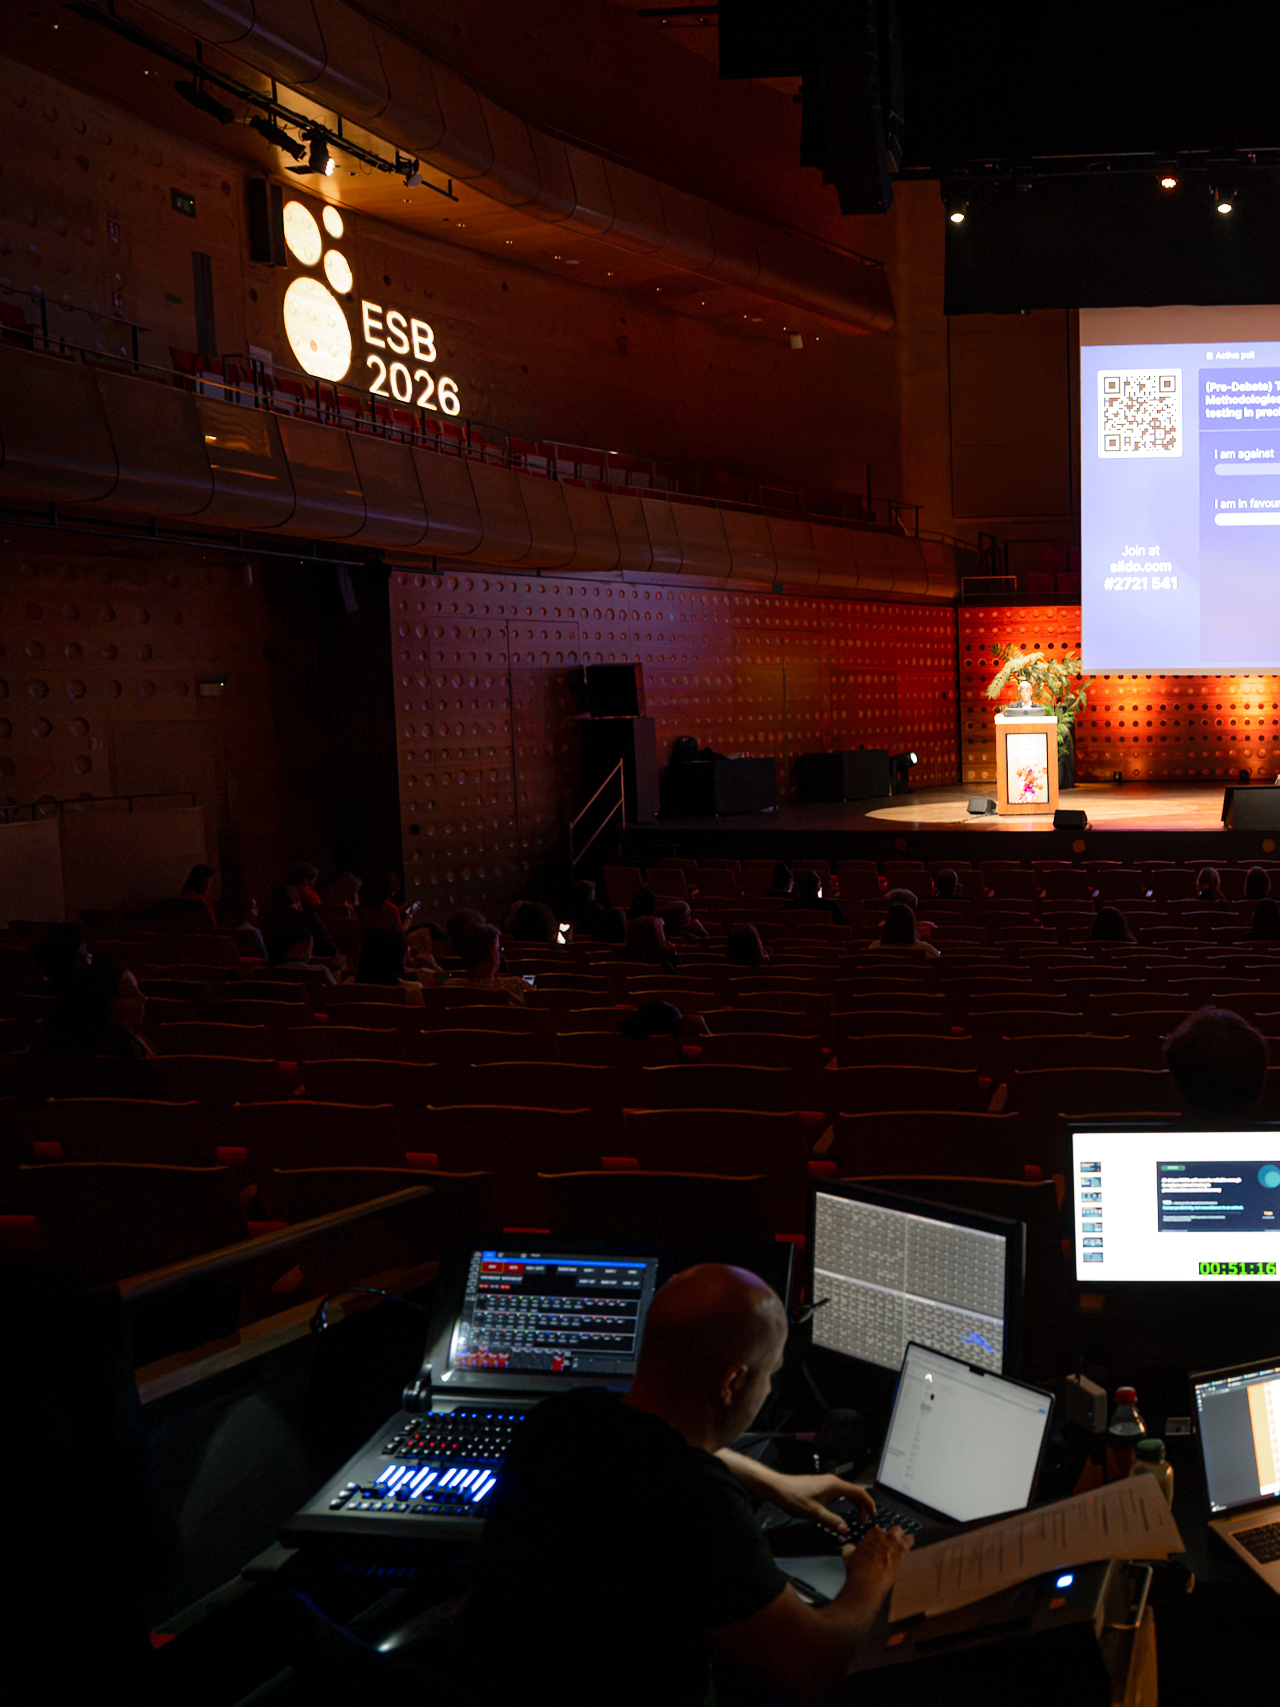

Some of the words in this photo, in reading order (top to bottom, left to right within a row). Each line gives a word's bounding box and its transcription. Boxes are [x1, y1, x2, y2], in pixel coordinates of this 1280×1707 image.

[361, 299, 437, 363] ESB
[1215, 351, 1239, 360] Active
[1240, 350, 1255, 360] poll
[366, 354, 461, 416] 2026
[1206, 380, 1272, 393] (Pre-Debate)
[1206, 407, 1242, 420] testing
[1244, 406, 1254, 418] in
[1214, 448, 1218, 460] I
[1220, 450, 1236, 460] am
[1238, 448, 1274, 462] against
[1214, 498, 1218, 509] I
[1220, 500, 1236, 509] am
[1238, 498, 1248, 509] in
[1121, 544, 1146, 557] Join
[1148, 545, 1161, 556] at
[1110, 560, 1172, 573] slido.com
[1104, 576, 1148, 590] #2721
[1152, 576, 1178, 590] 541
[1200, 1262, 1276, 1275] 00:51:16
